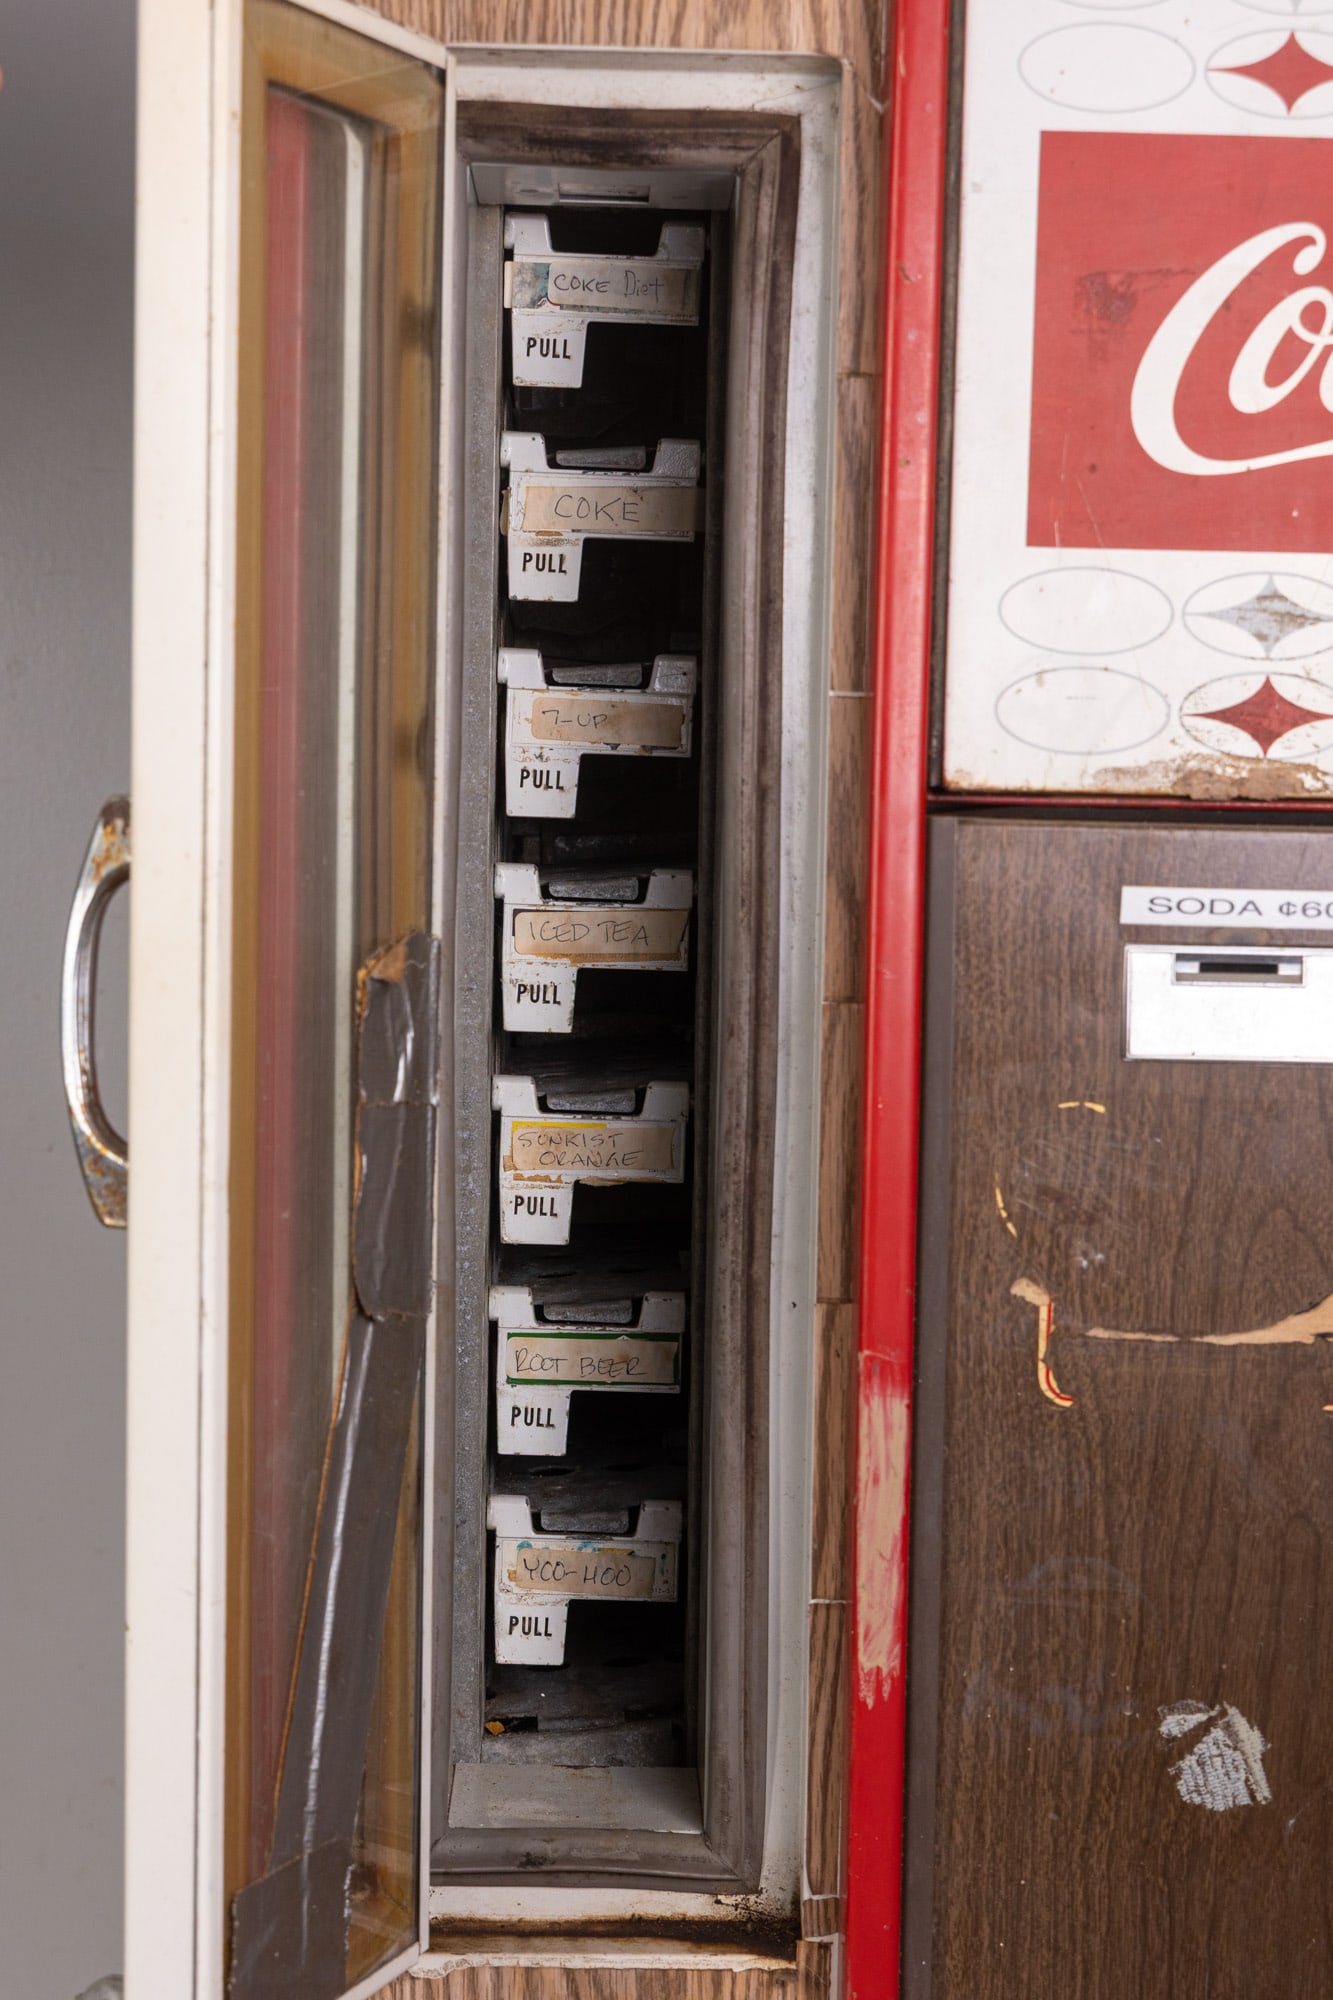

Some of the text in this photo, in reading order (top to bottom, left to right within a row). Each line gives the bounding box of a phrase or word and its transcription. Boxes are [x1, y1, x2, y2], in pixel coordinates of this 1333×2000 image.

[553, 269, 665, 303] COKE Diet
[525, 336, 572, 360] PULL
[553, 494, 641, 523] COKE
[521, 552, 568, 575] PULL
[541, 709, 609, 729] 7-UP
[519, 768, 565, 790] PULL
[1147, 896, 1264, 917] SODA
[529, 919, 650, 947] ICED TEA
[516, 983, 562, 1006] PULL
[517, 1131, 625, 1149] SUNKIST
[538, 1150, 646, 1168] ORANGE
[513, 1194, 558, 1218] PULL
[515, 1347, 649, 1378] ROOT BEER
[510, 1406, 556, 1428] PULL
[522, 1558, 632, 1587] YOO-HOO
[508, 1615, 553, 1638] PULL
